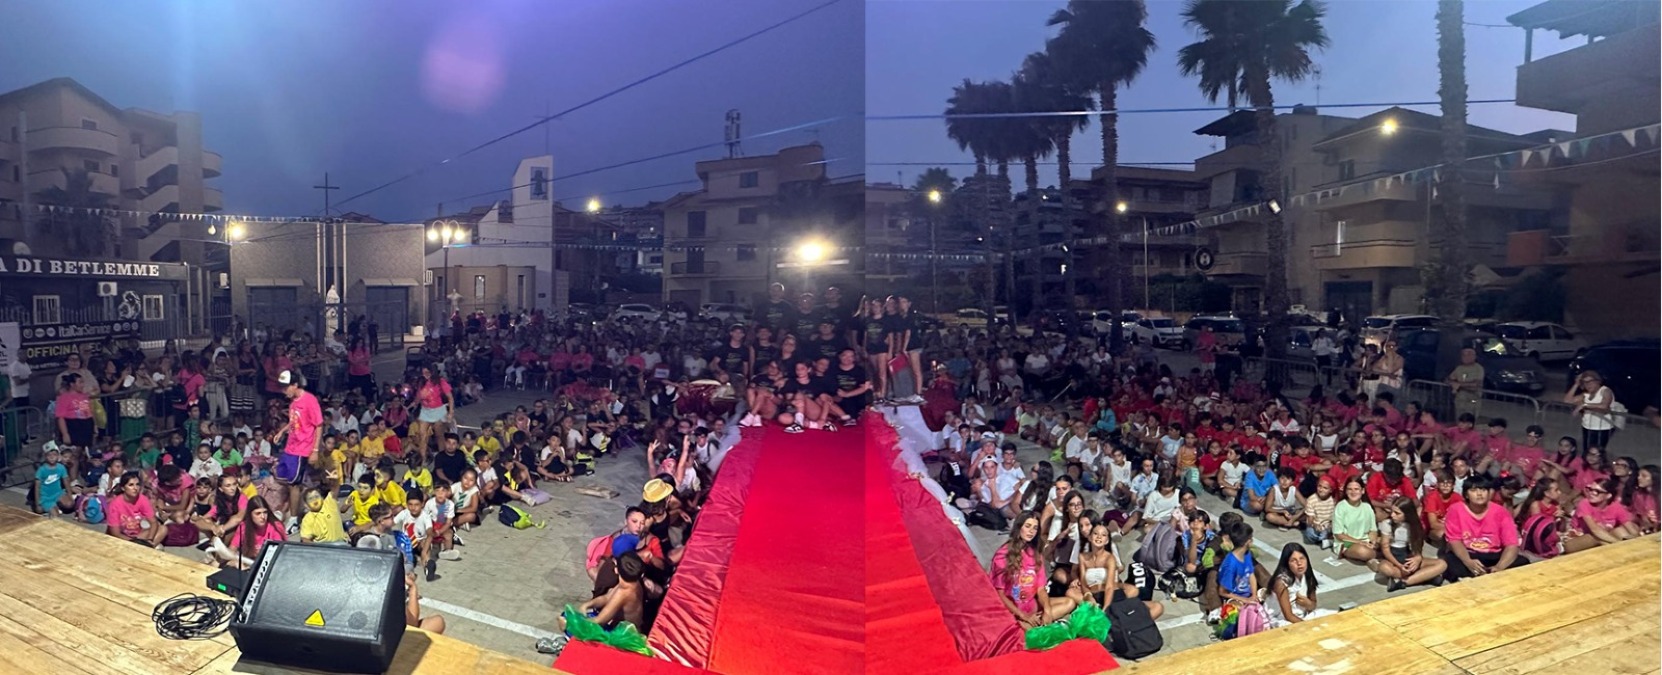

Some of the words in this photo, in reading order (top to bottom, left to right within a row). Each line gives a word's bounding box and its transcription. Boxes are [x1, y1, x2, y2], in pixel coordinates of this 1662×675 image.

[16, 258, 43, 274] DI
[49, 260, 160, 276] BETLEMME
[26, 344, 80, 358] OFFICINA
